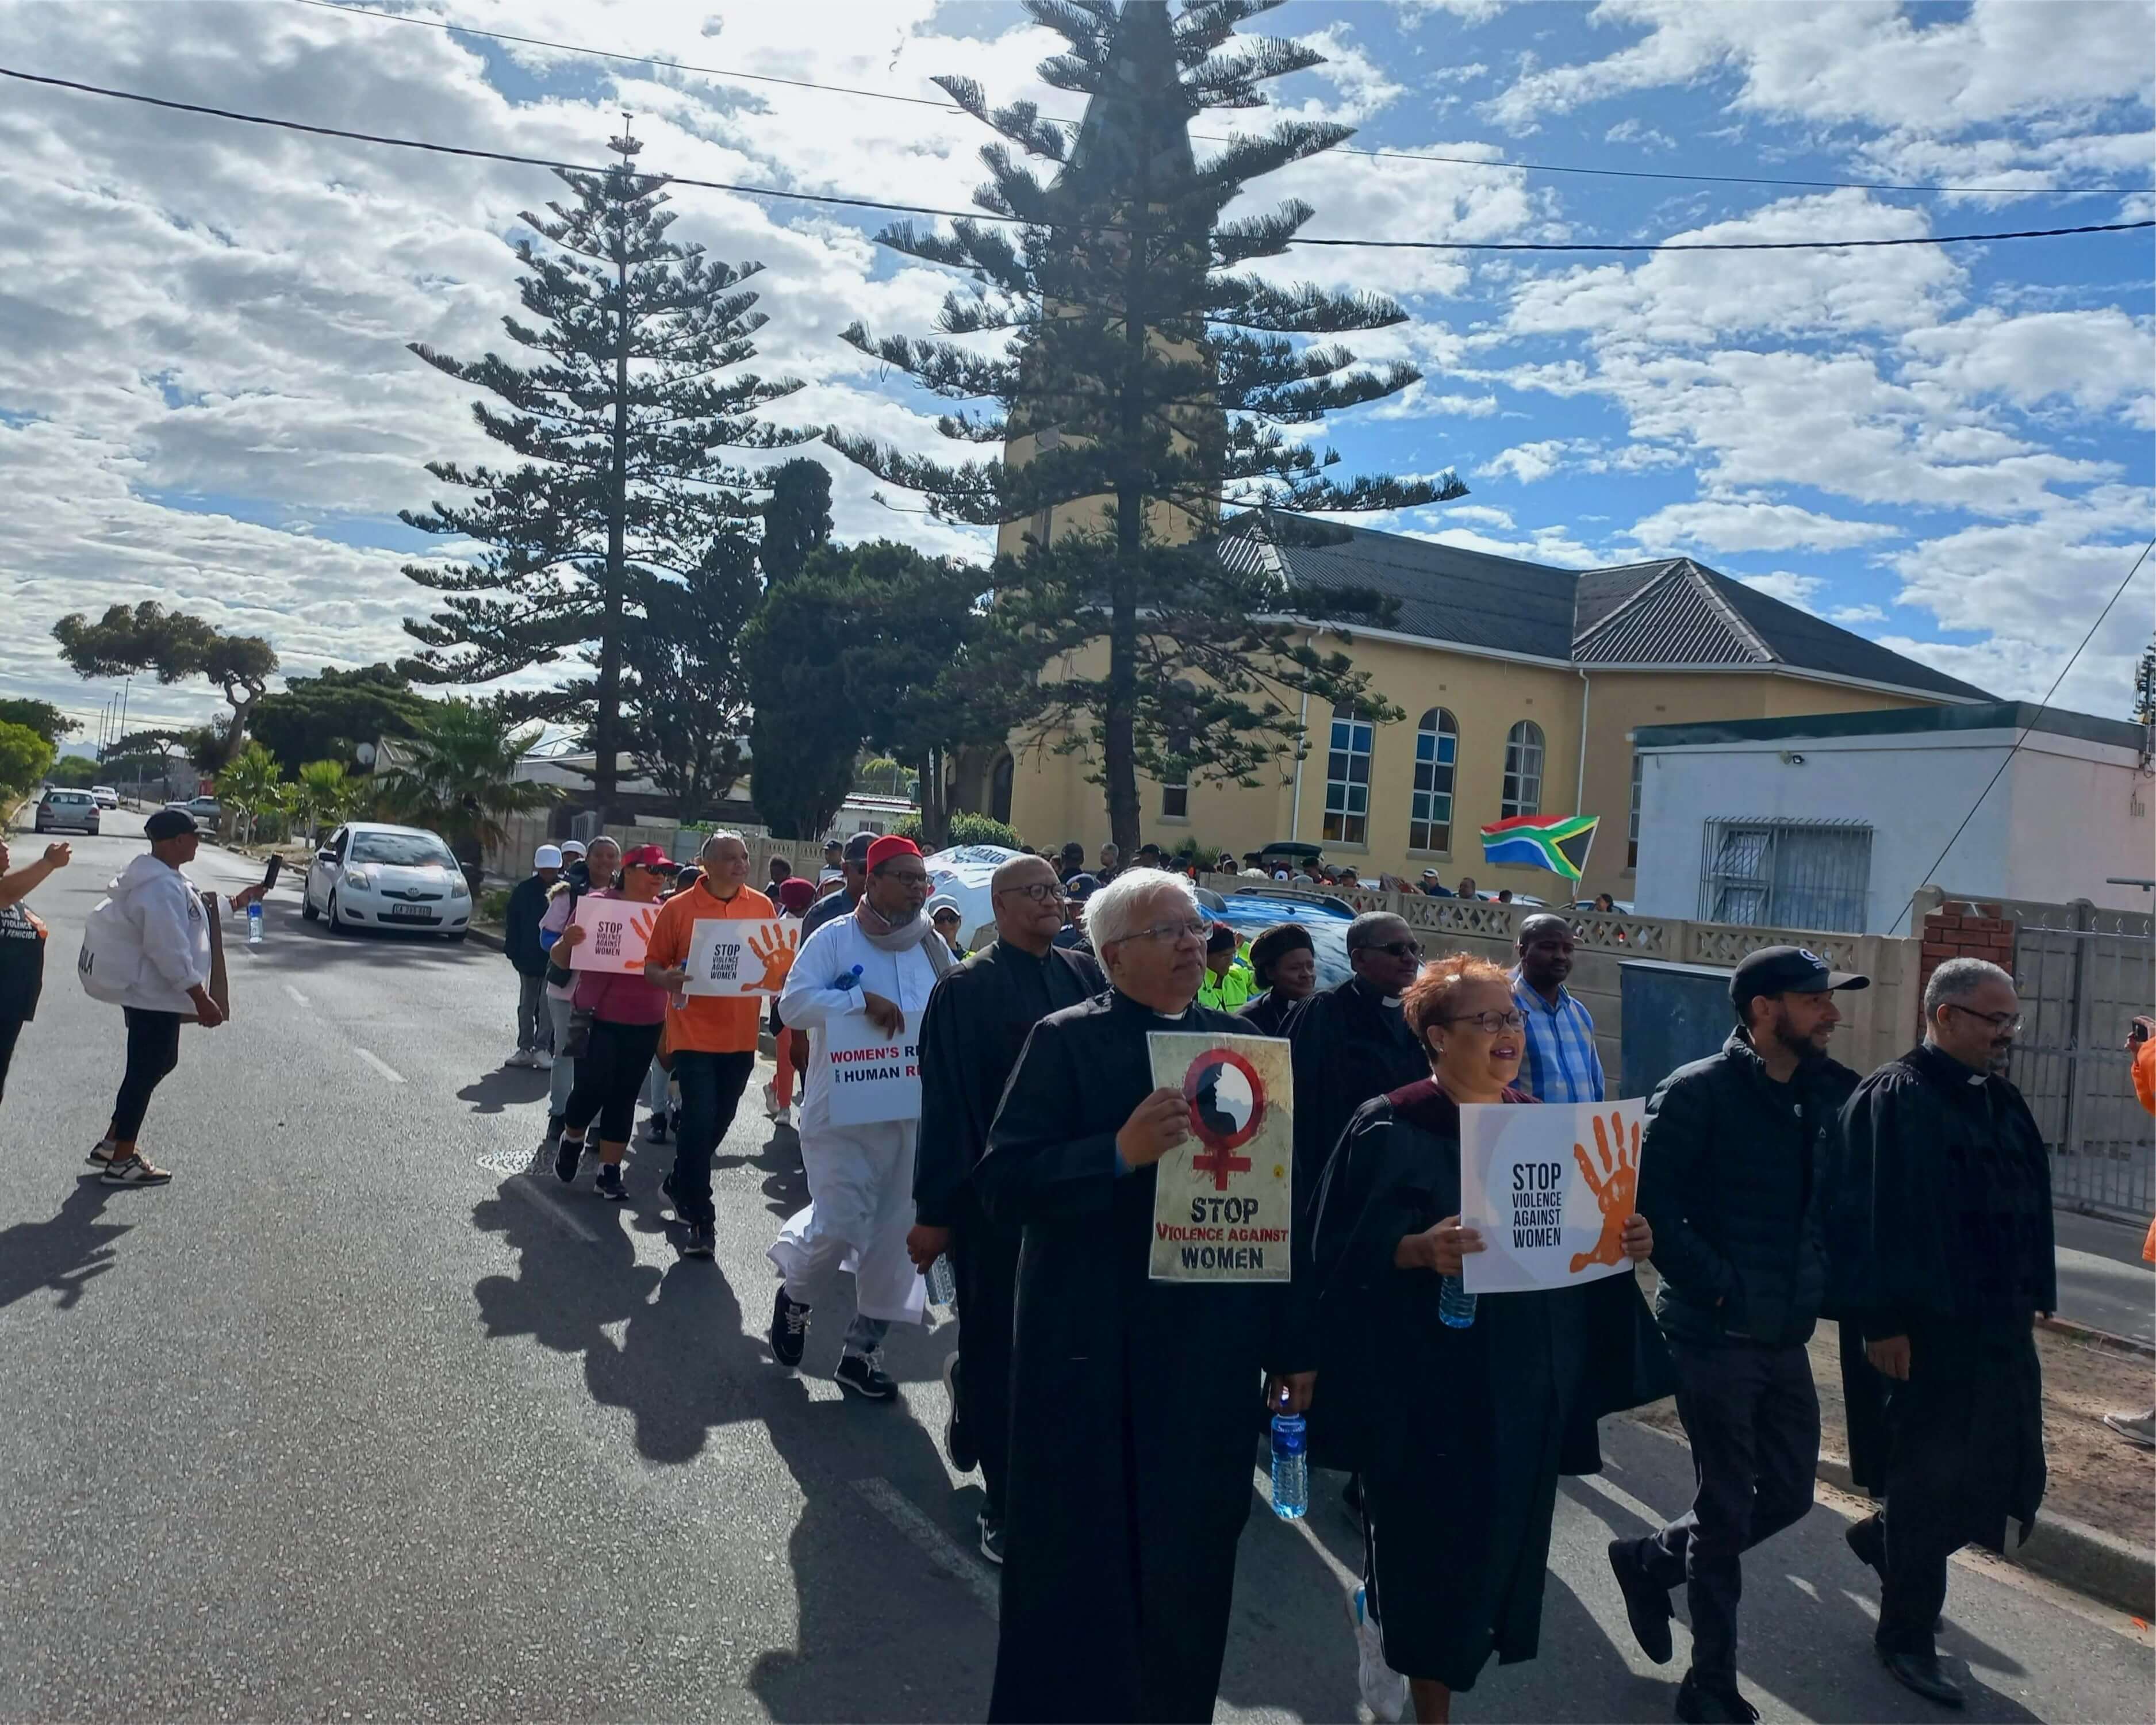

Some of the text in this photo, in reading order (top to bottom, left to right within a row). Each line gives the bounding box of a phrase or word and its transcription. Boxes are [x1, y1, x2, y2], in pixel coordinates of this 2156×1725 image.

[598, 921, 623, 933] STOP
[595, 947, 621, 956] WOMEN
[714, 944, 740, 956] STOP
[711, 971, 737, 980] WOMEN
[830, 1045, 920, 1064] WOMEN'S RI
[844, 1067, 900, 1083] HUMAN
[906, 1065, 920, 1076] RI
[1513, 1163, 1562, 1191] STOP
[1512, 1191, 1562, 1208] VIOLENCE
[1191, 1197, 1259, 1224] STOP
[1513, 1209, 1562, 1227] AGAINST
[1227, 1228, 1288, 1242] AGAINST
[1513, 1227, 1561, 1248] WOMEN
[1181, 1246, 1264, 1269] WOMEN
